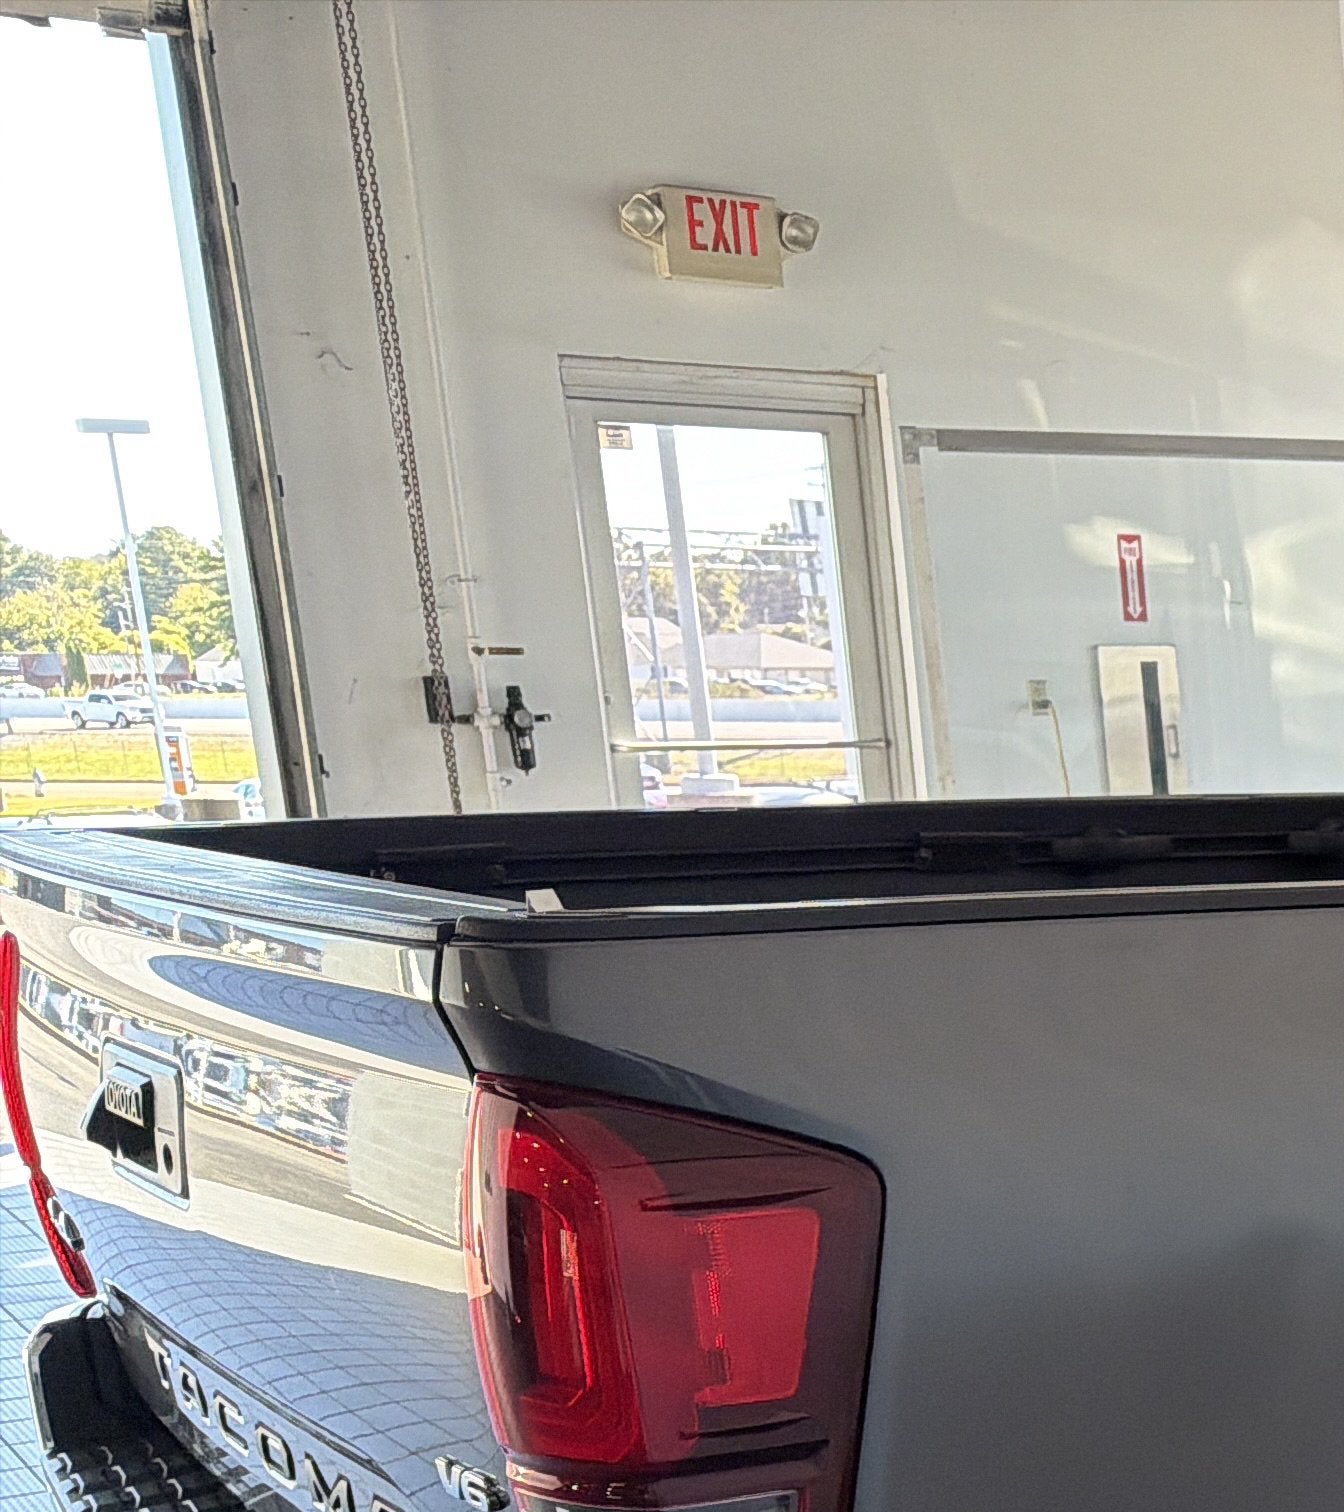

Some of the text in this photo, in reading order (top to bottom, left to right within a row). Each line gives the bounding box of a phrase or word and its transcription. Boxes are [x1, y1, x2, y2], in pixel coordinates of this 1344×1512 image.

[685, 194, 760, 256] EXIT
[104, 1079, 144, 1123] TOYOTA
[434, 1455, 495, 1512] V6
